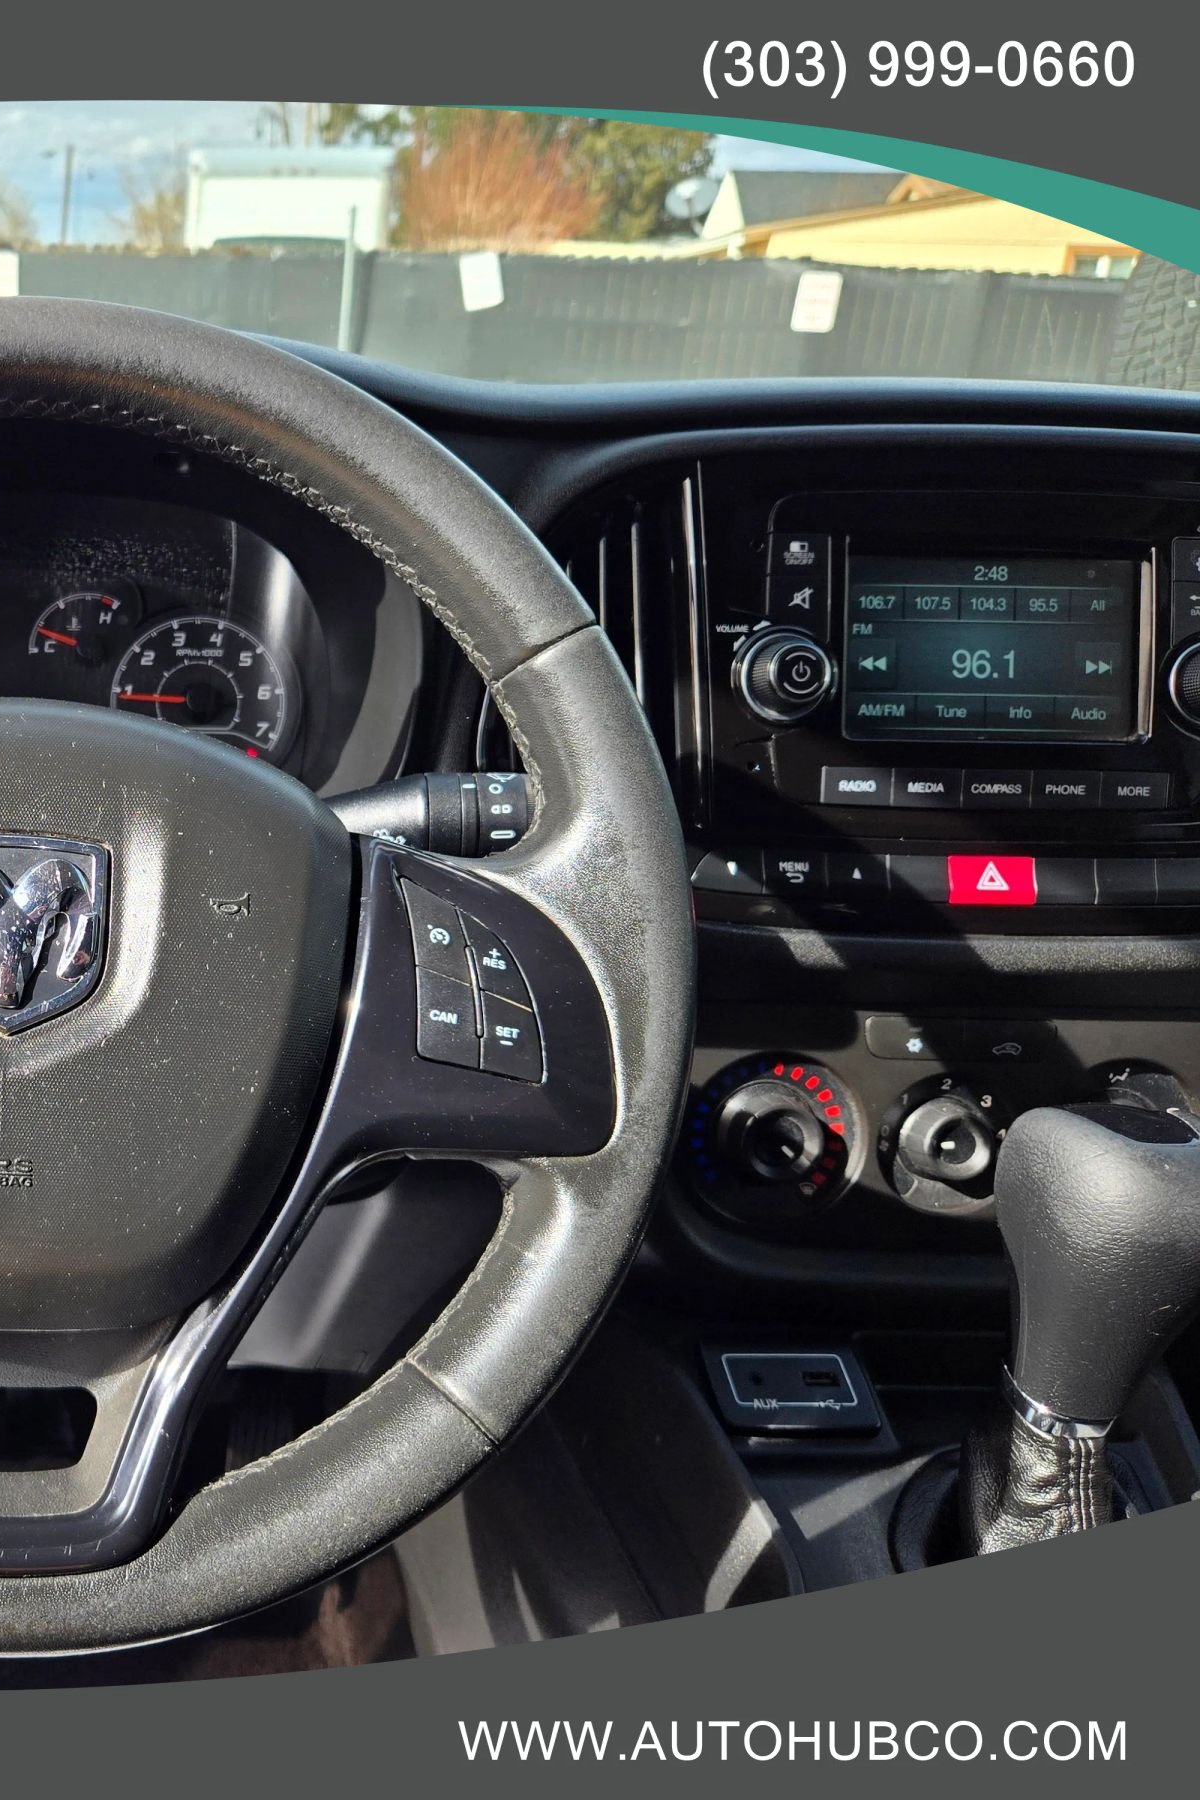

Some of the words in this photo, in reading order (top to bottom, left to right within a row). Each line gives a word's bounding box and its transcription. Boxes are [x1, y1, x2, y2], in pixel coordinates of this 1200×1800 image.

[973, 565, 1008, 581] 2:48
[858, 596, 896, 610] 106.7
[914, 597, 951, 611] 107.5
[970, 598, 1006, 611] 104.3
[1029, 598, 1058, 612] 95.5
[1090, 599, 1106, 611] All
[99, 612, 112, 624] H
[715, 625, 749, 633] VOLUME
[852, 624, 873, 635] FM
[44, 640, 56, 653] C
[172, 633, 186, 647] 3
[209, 633, 223, 647] 4
[140, 651, 155, 666] 2
[238, 652, 253, 667] 5
[951, 649, 1016, 679] 96.1
[125, 685, 133, 695] 1
[257, 686, 271, 700] 6
[858, 705, 905, 716] AM/FM
[936, 705, 967, 718] Tune
[1009, 706, 1032, 719] Info
[1071, 707, 1106, 720] Audio
[256, 723, 270, 737] 7
[838, 779, 877, 793] RADIO
[907, 781, 944, 794] MEDIA
[971, 783, 1022, 795] COMPASS
[1045, 784, 1086, 796] PHONE
[1117, 785, 1151, 797] MORE
[778, 862, 809, 873] MENU
[483, 957, 506, 970] RES
[430, 1010, 458, 1024] CAN
[495, 1026, 519, 1039] SET
[940, 1078, 952, 1090] 2
[901, 1094, 909, 1105] 1
[980, 1095, 993, 1107] 3
[753, 1398, 778, 1410] AUX
